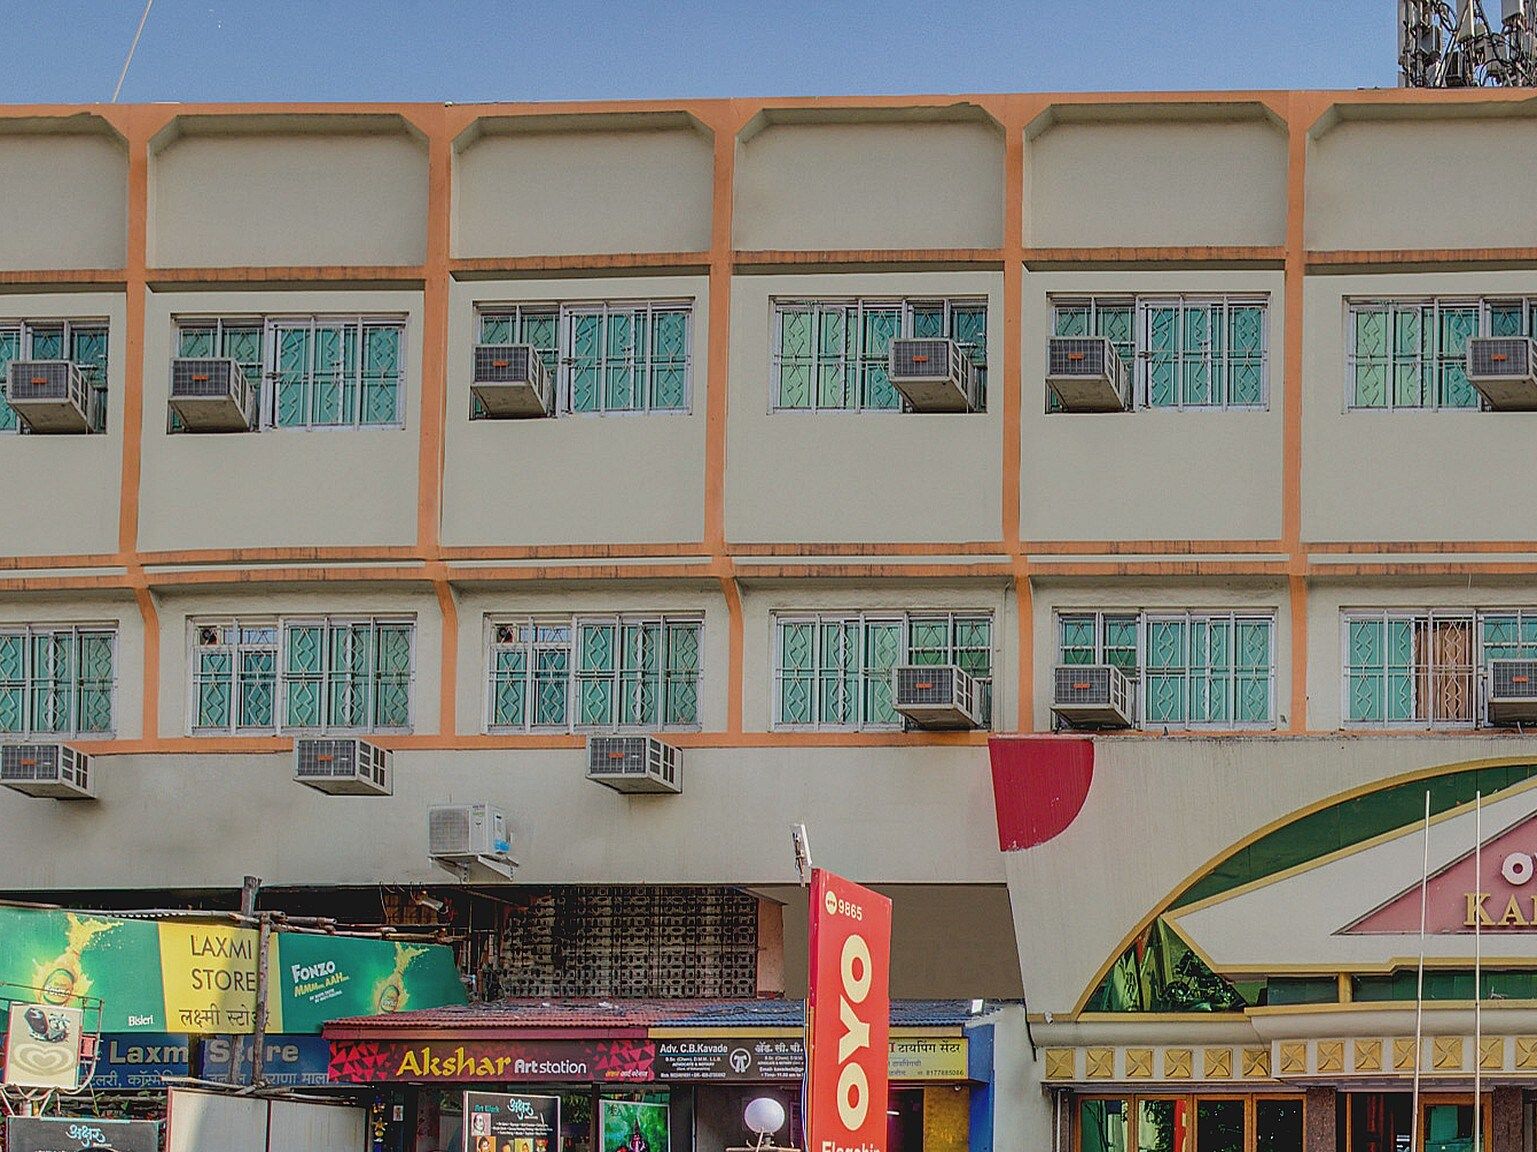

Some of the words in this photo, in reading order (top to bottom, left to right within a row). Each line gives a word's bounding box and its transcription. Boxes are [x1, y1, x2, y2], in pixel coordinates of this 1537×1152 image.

[838, 899, 863, 921] 9865
[191, 935, 252, 960] LAXMI
[192, 969, 257, 992] STORE
[128, 1015, 154, 1027] Bisleri
[837, 934, 872, 1131] OYO
[110, 1040, 188, 1063] Laxm
[396, 1046, 511, 1077] Akshar
